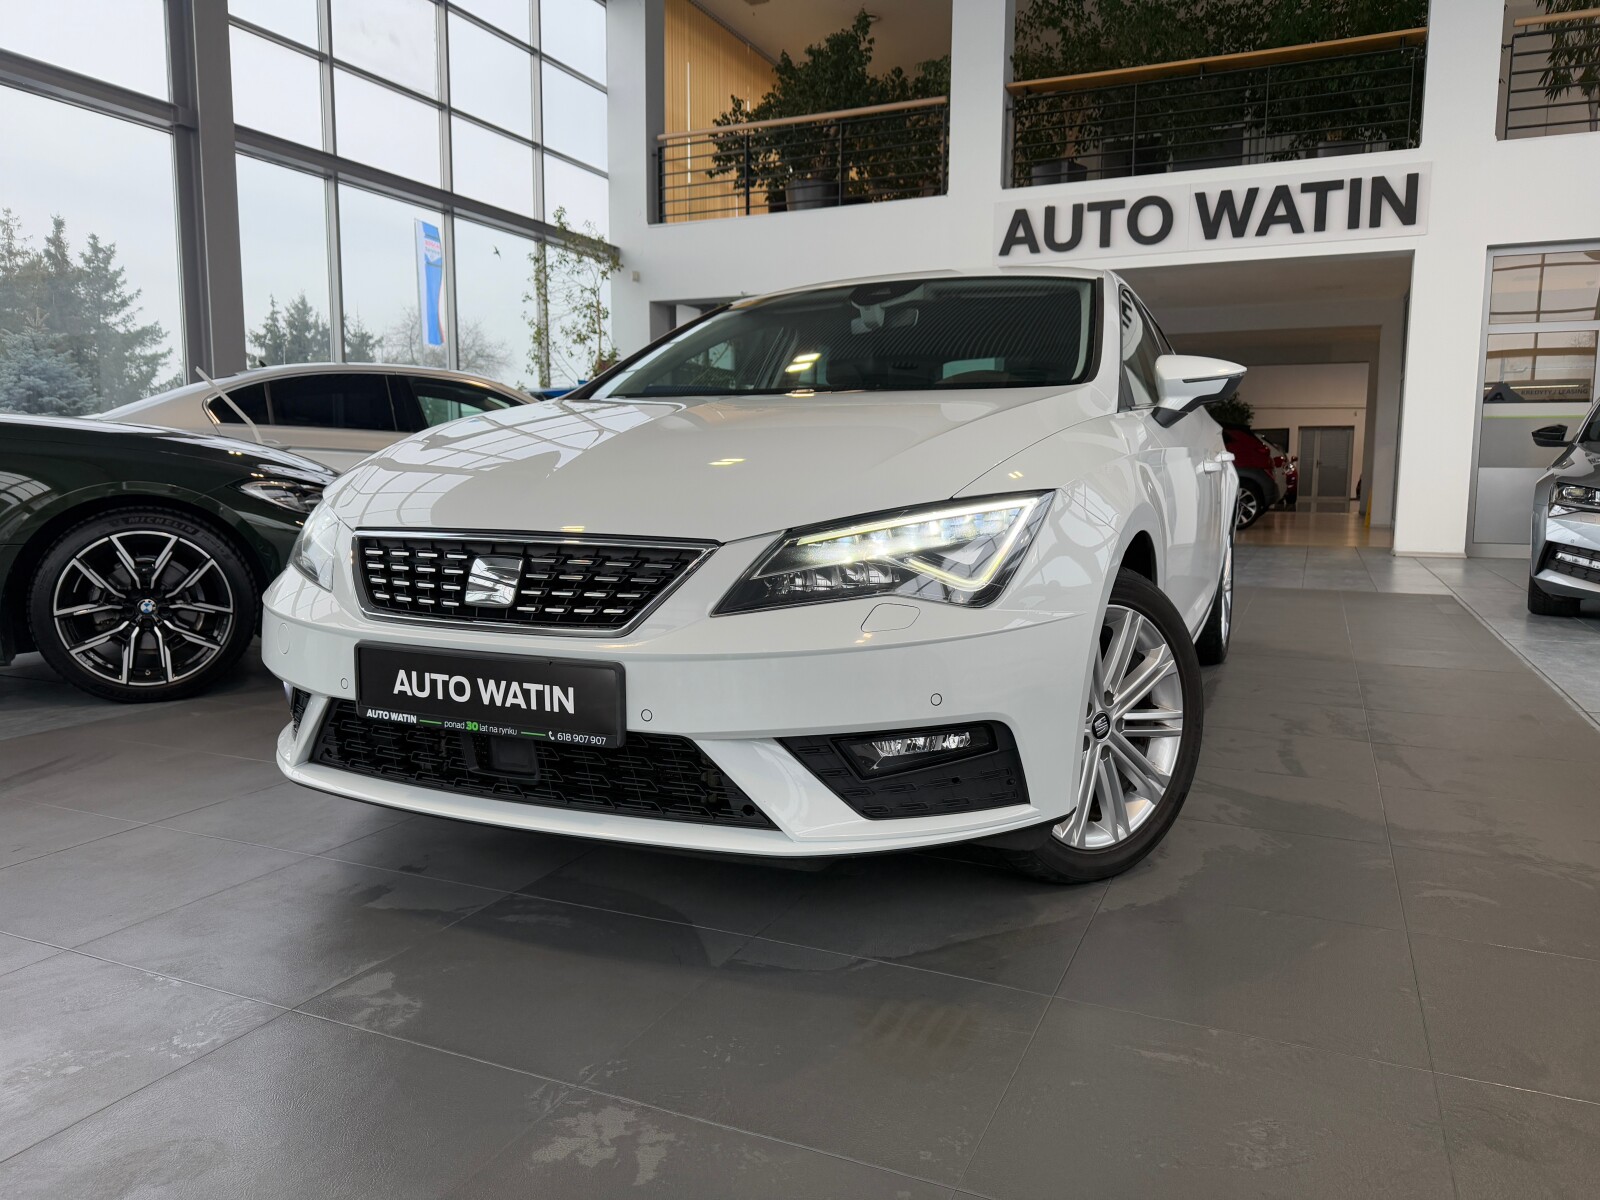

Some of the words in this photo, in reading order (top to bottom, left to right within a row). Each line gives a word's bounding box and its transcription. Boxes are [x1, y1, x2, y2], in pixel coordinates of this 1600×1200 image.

[999, 196, 1173, 257] AUTO
[1194, 173, 1420, 241] WATIN
[128, 516, 196, 534] MICHELIN
[393, 670, 471, 703] AUTO
[477, 678, 575, 714] WATIN
[366, 709, 390, 720] AUTO
[390, 712, 417, 724] WATIN
[444, 721, 465, 730] ponad
[466, 721, 479, 731] 30
[480, 724, 488, 732] lat
[498, 727, 518, 736] rynku
[557, 732, 572, 742] 618
[572, 734, 588, 744] 907
[590, 736, 607, 745] 907
